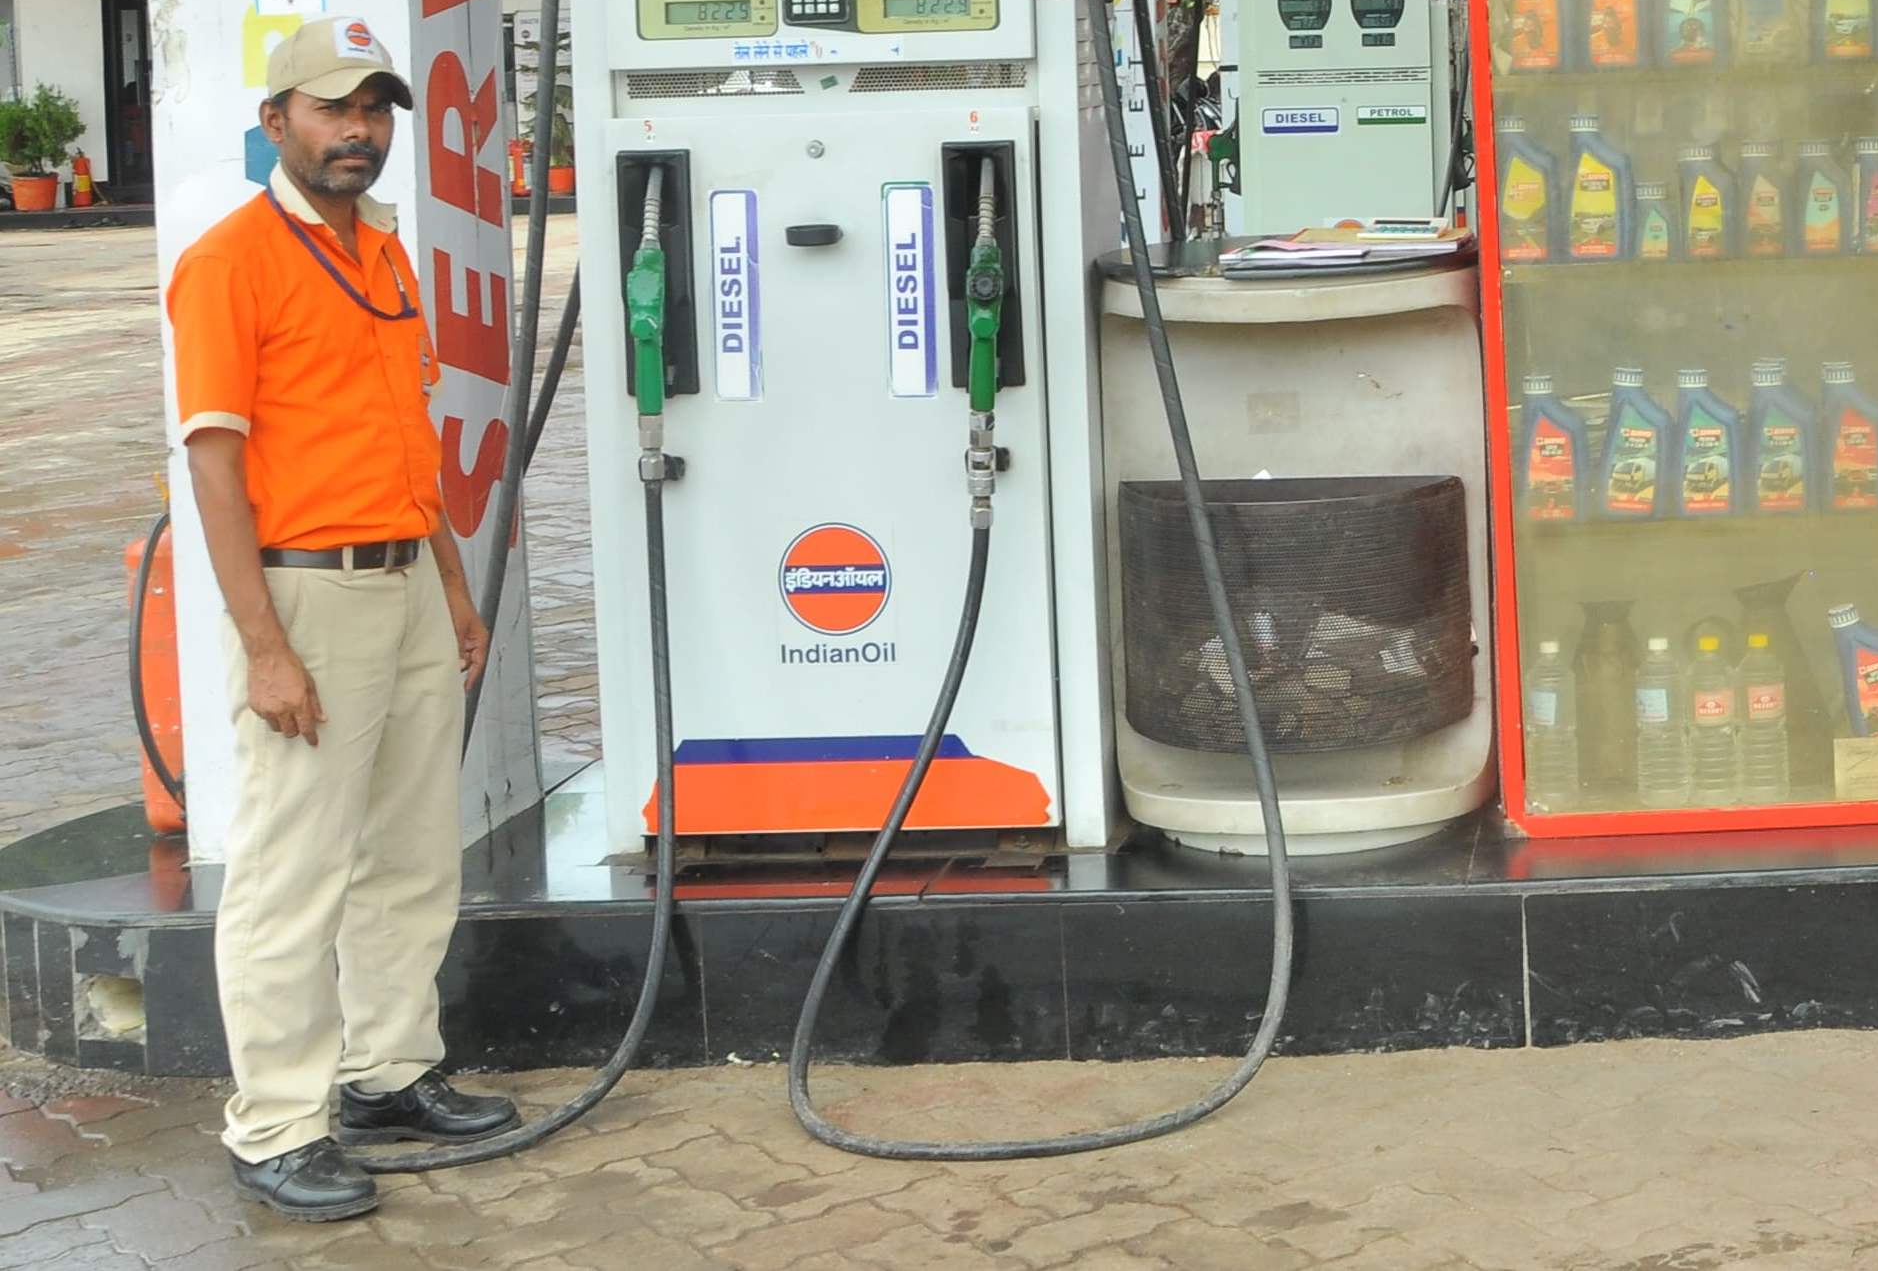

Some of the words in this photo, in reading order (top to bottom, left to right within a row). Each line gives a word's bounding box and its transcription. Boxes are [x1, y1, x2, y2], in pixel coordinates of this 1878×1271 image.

[1275, 112, 1327, 124] DIESEL
[1369, 108, 1414, 117] PETROL
[643, 120, 653, 132] 5
[721, 235, 744, 354] DIESEL
[896, 232, 920, 350] DIESEL
[785, 566, 884, 593] इंडियनऑयल
[780, 642, 896, 664] IndianOil
